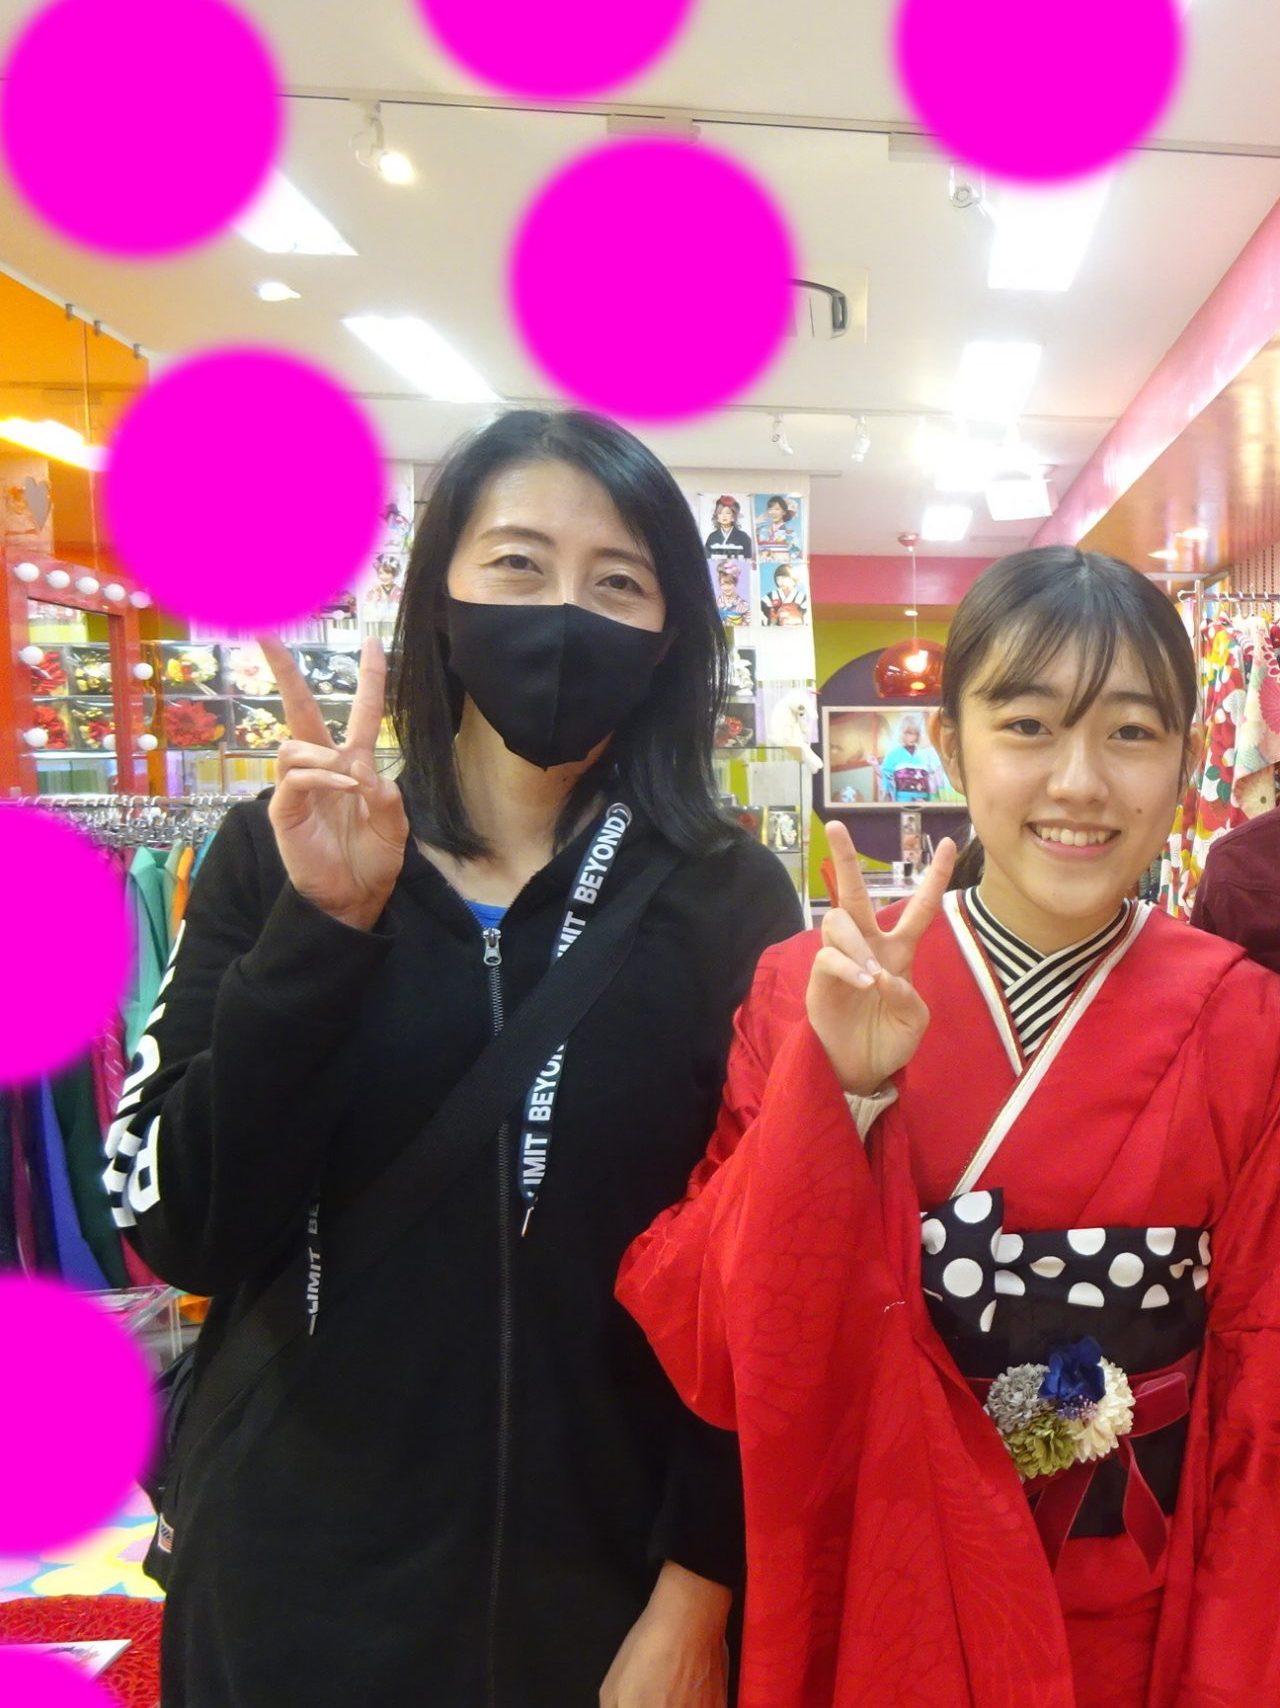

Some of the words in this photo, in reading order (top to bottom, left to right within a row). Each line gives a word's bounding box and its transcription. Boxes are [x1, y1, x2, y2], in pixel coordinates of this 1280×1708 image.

[573, 816, 627, 904] BEYOND
[523, 1132, 548, 1198] IMIT
[306, 1246, 321, 1314] LIMIT
